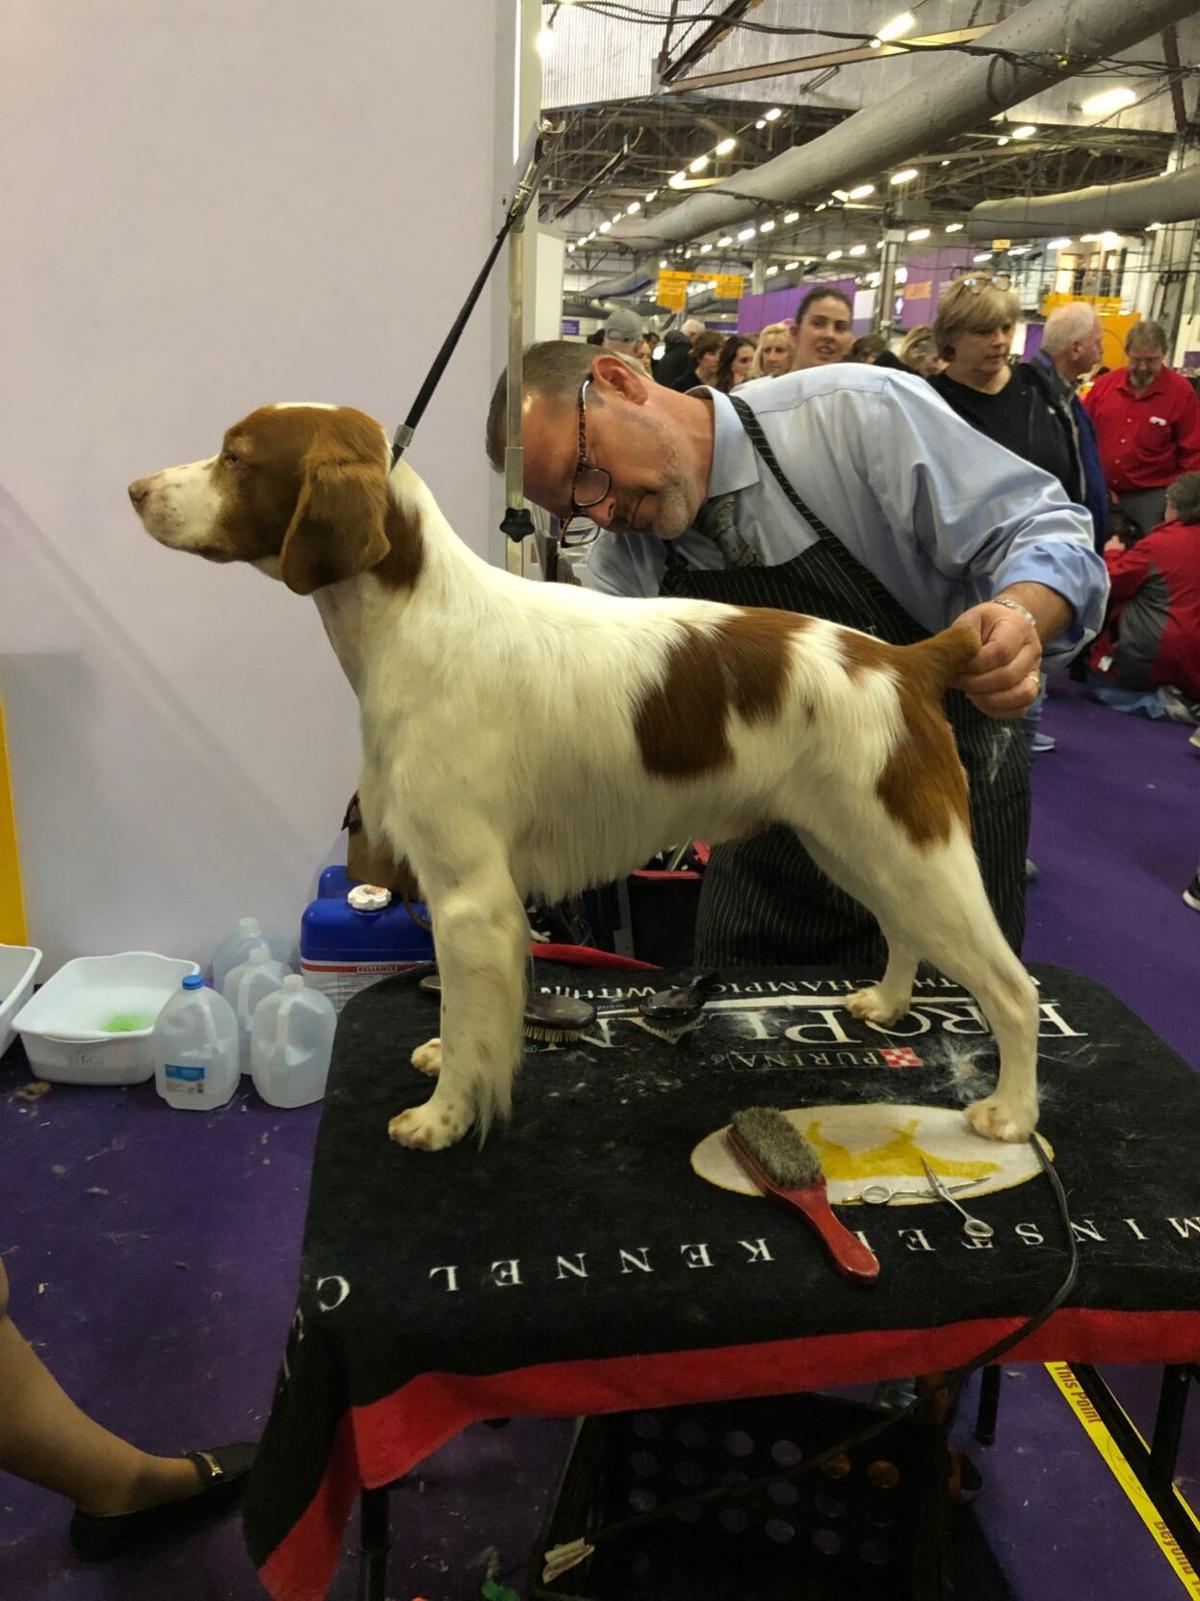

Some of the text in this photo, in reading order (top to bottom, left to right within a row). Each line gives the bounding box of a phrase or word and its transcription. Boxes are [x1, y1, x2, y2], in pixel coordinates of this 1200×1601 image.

[672, 979, 881, 995] HAMPIO
[914, 977, 959, 988] TH
[737, 1051, 878, 1067] PURINA
[430, 1238, 777, 1292] KENNEL
[1054, 1364, 1101, 1423] This Point
